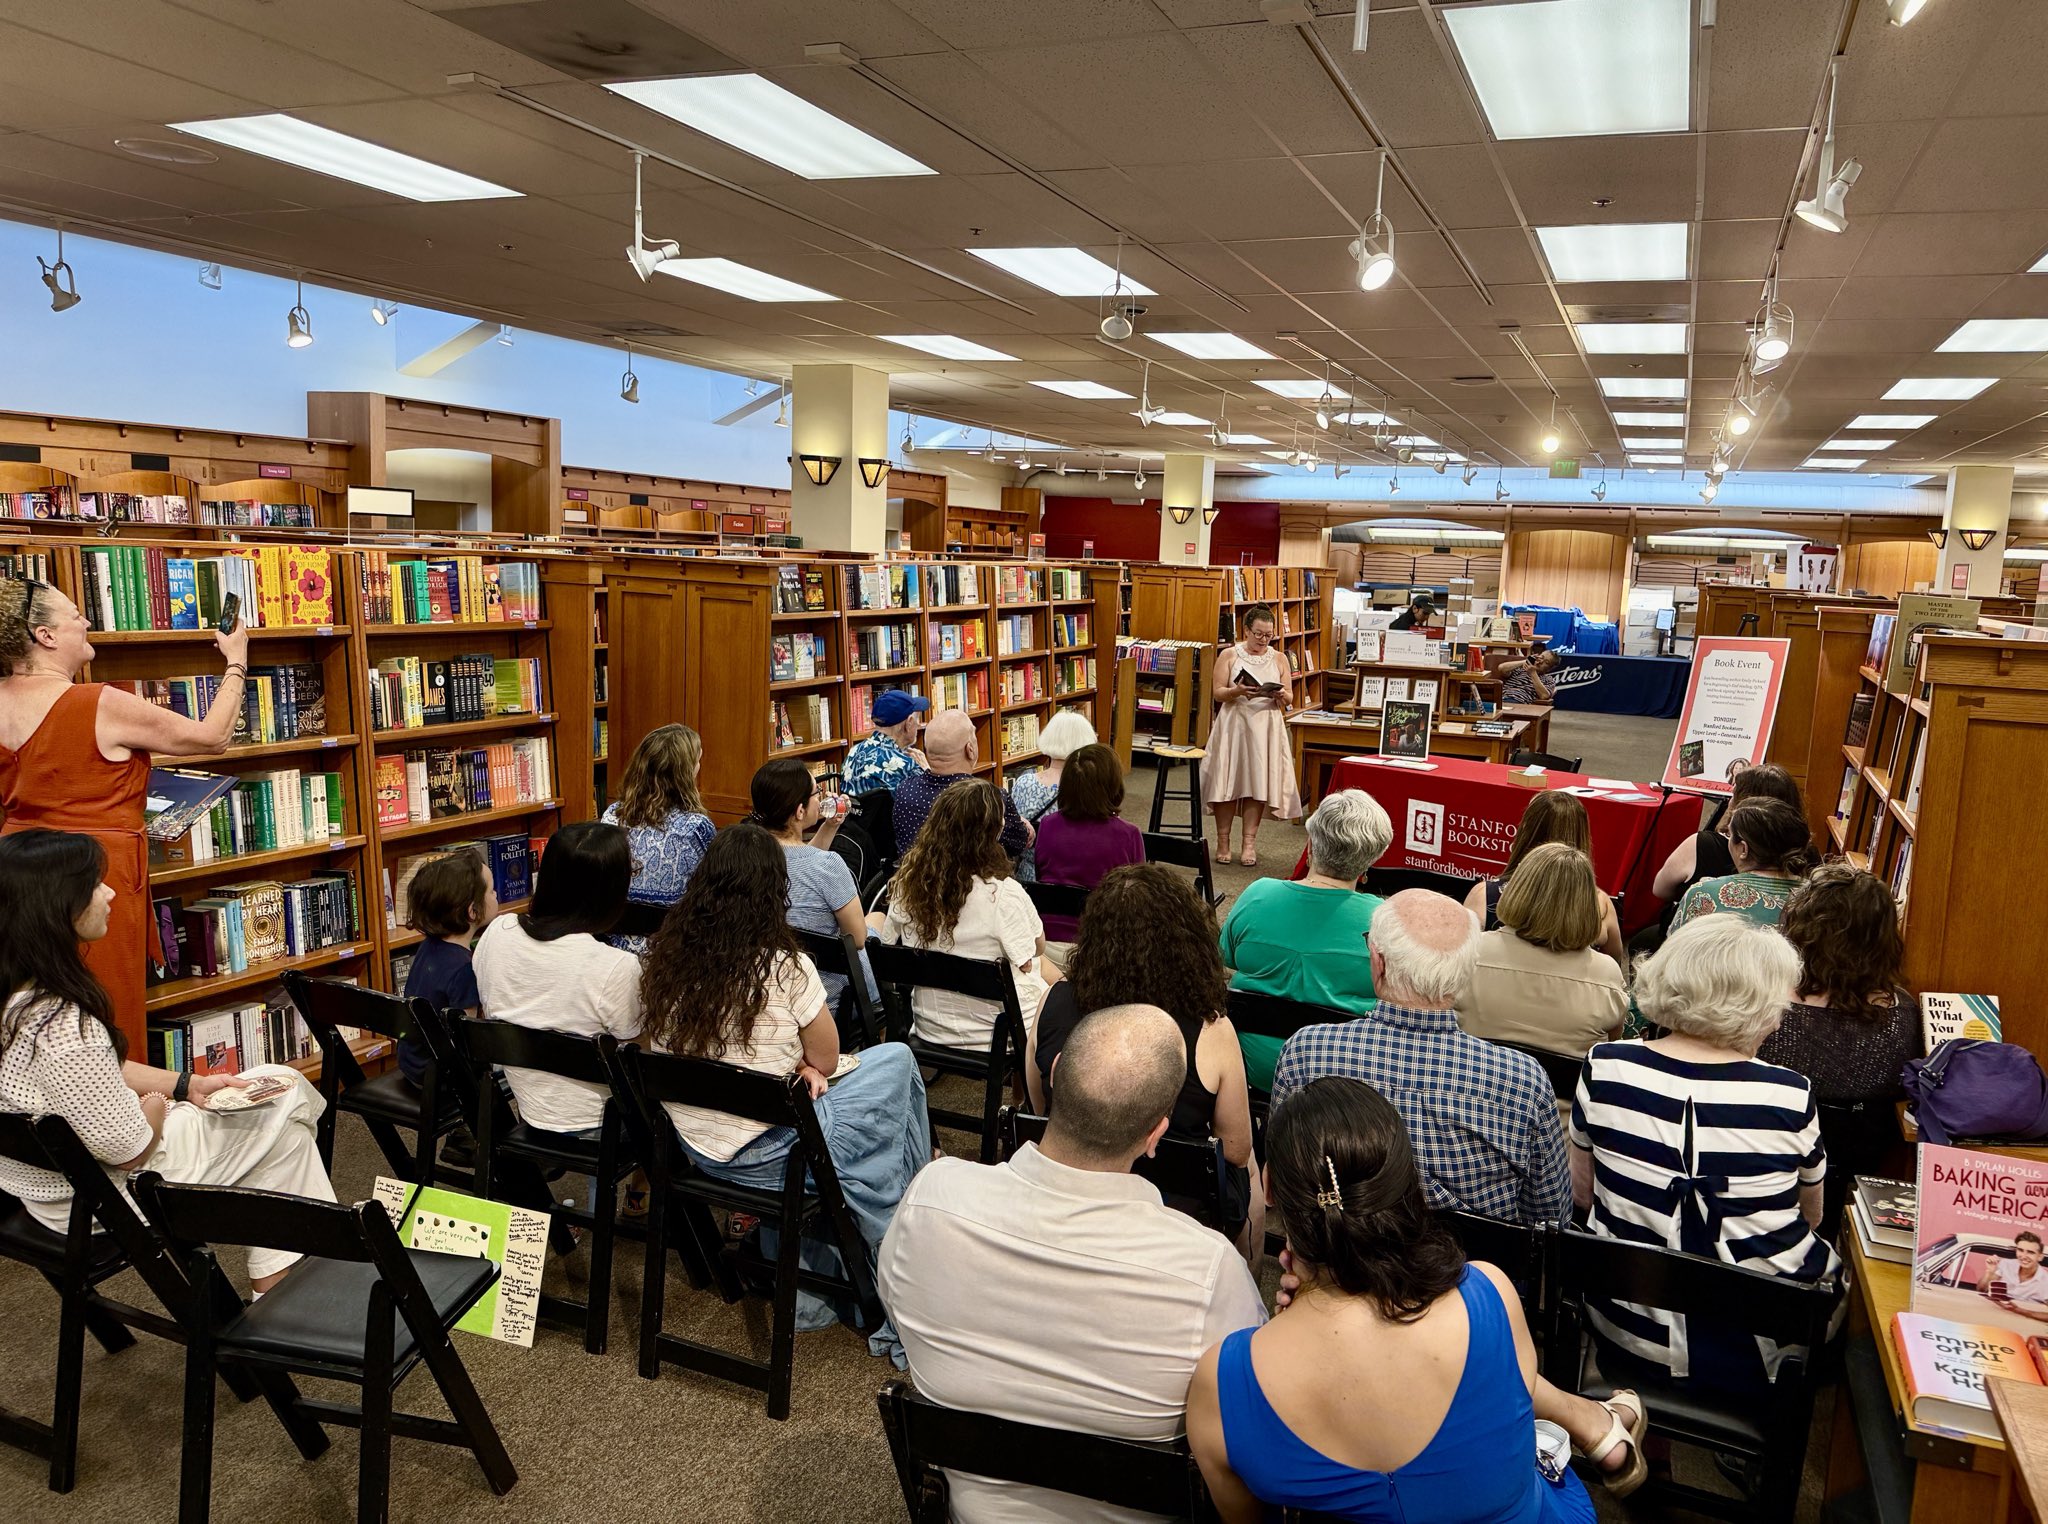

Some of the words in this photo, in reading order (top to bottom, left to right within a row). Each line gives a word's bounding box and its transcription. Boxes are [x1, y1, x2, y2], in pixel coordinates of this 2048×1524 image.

[169, 568, 193, 580] RICAN
[170, 581, 184, 593] IRT
[1714, 659, 1736, 668] Book
[1737, 660, 1761, 669] Event
[295, 680, 320, 691] OLEN
[422, 663, 446, 708] JAMES
[298, 710, 318, 718] ONA
[298, 721, 318, 730] AVIS
[440, 760, 452, 772] THE
[1448, 813, 1517, 838] STANFO
[507, 844, 520, 852] KEN
[1448, 830, 1513, 853] BOOKST
[501, 848, 526, 862] FOLLETT
[241, 889, 281, 908] LEARNED
[241, 907, 252, 920] BY
[256, 902, 282, 917] HEART
[254, 935, 275, 948] EMMA
[1928, 997, 1953, 1010] Buy
[1928, 1010, 1964, 1022] What
[1930, 1022, 1954, 1034] You
[1931, 1036, 1951, 1046] Lo
[1964, 1158, 1970, 1167] B
[1975, 1160, 2005, 1173] DYLAN
[2008, 1166, 2042, 1179] HOLLIS
[1933, 1163, 2016, 1196] BAKING
[1952, 1190, 2048, 1222] AMERICA
[1963, 1210, 1989, 1220] vintage
[1990, 1216, 2012, 1224] recipe
[2014, 1220, 2032, 1228] road
[2032, 1222, 2046, 1230] trip
[424, 1225, 435, 1235] We
[1920, 1330, 2016, 1355] Empire
[1936, 1344, 1963, 1356] Of
[1971, 1350, 2004, 1363] AI
[1934, 1362, 1984, 1380] Kar
